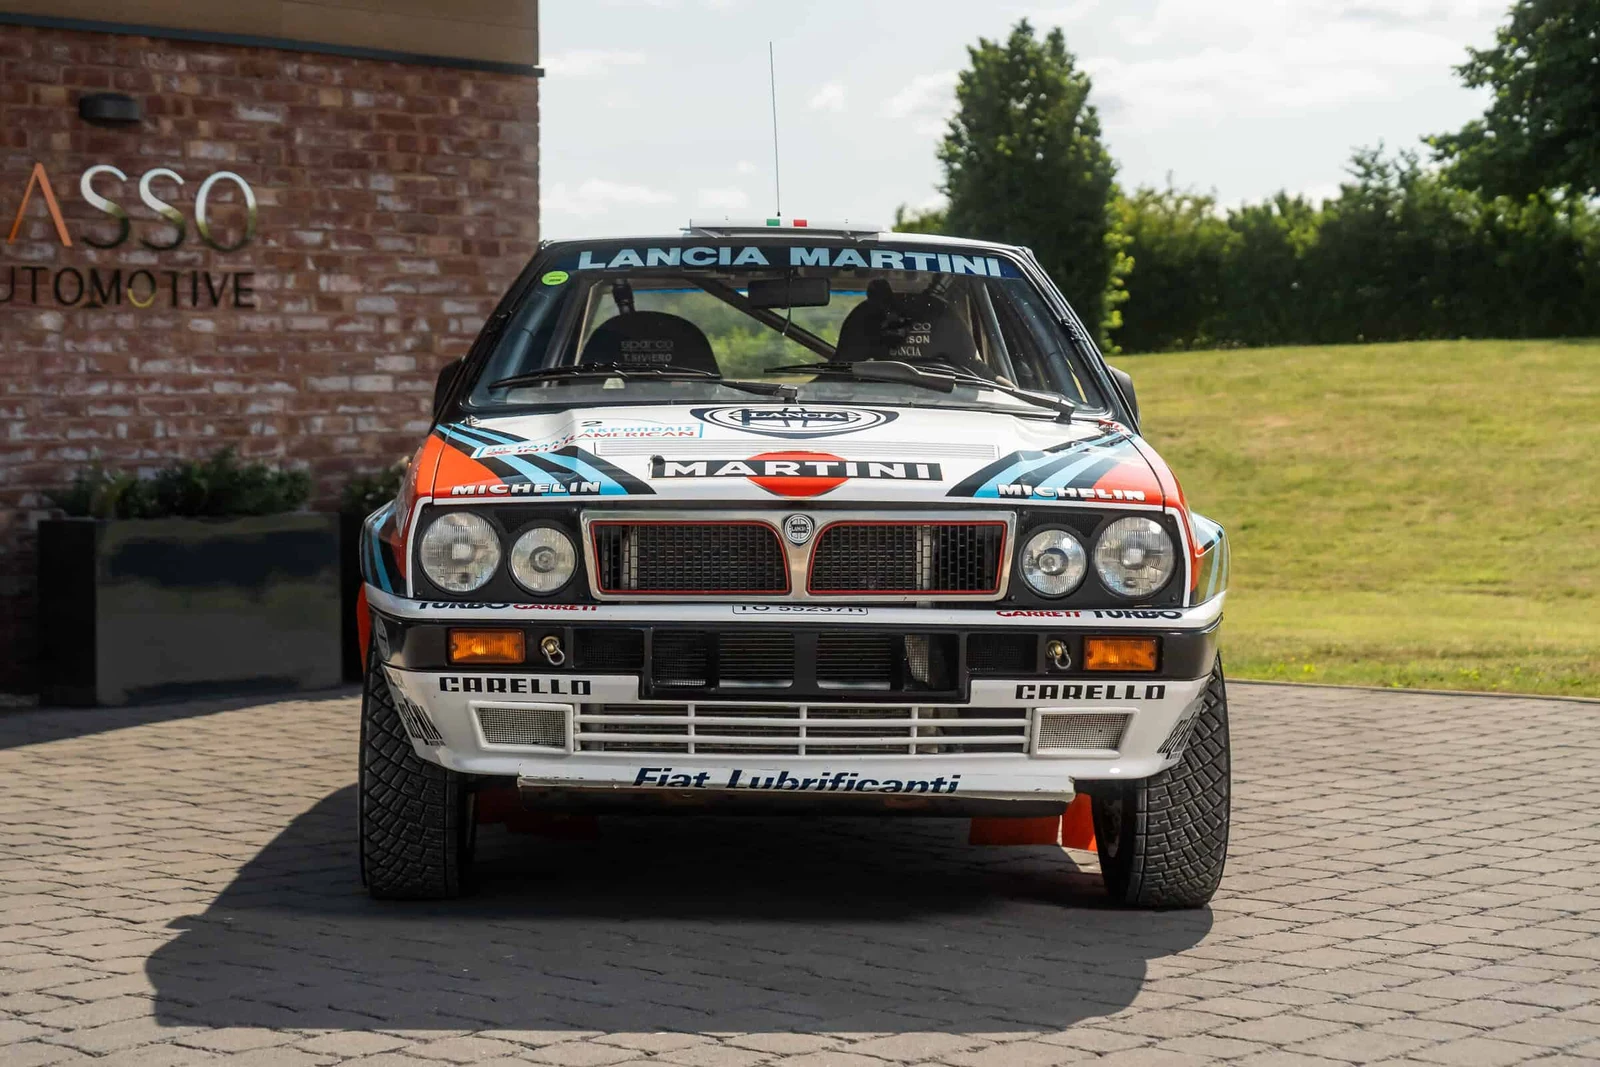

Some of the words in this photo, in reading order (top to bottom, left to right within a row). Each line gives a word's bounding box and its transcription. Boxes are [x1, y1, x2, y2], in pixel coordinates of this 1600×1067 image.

[578, 246, 770, 270] LANCIA
[790, 247, 1002, 277] MARTINI
[663, 461, 931, 479] MARTINI
[451, 481, 601, 496] MICHELIN
[997, 484, 1146, 501] MICHELIN
[439, 676, 592, 696] CARELLO
[1015, 684, 1167, 700] CARELLO
[632, 767, 711, 789] Fiat
[725, 769, 962, 795] Lubrificanti
